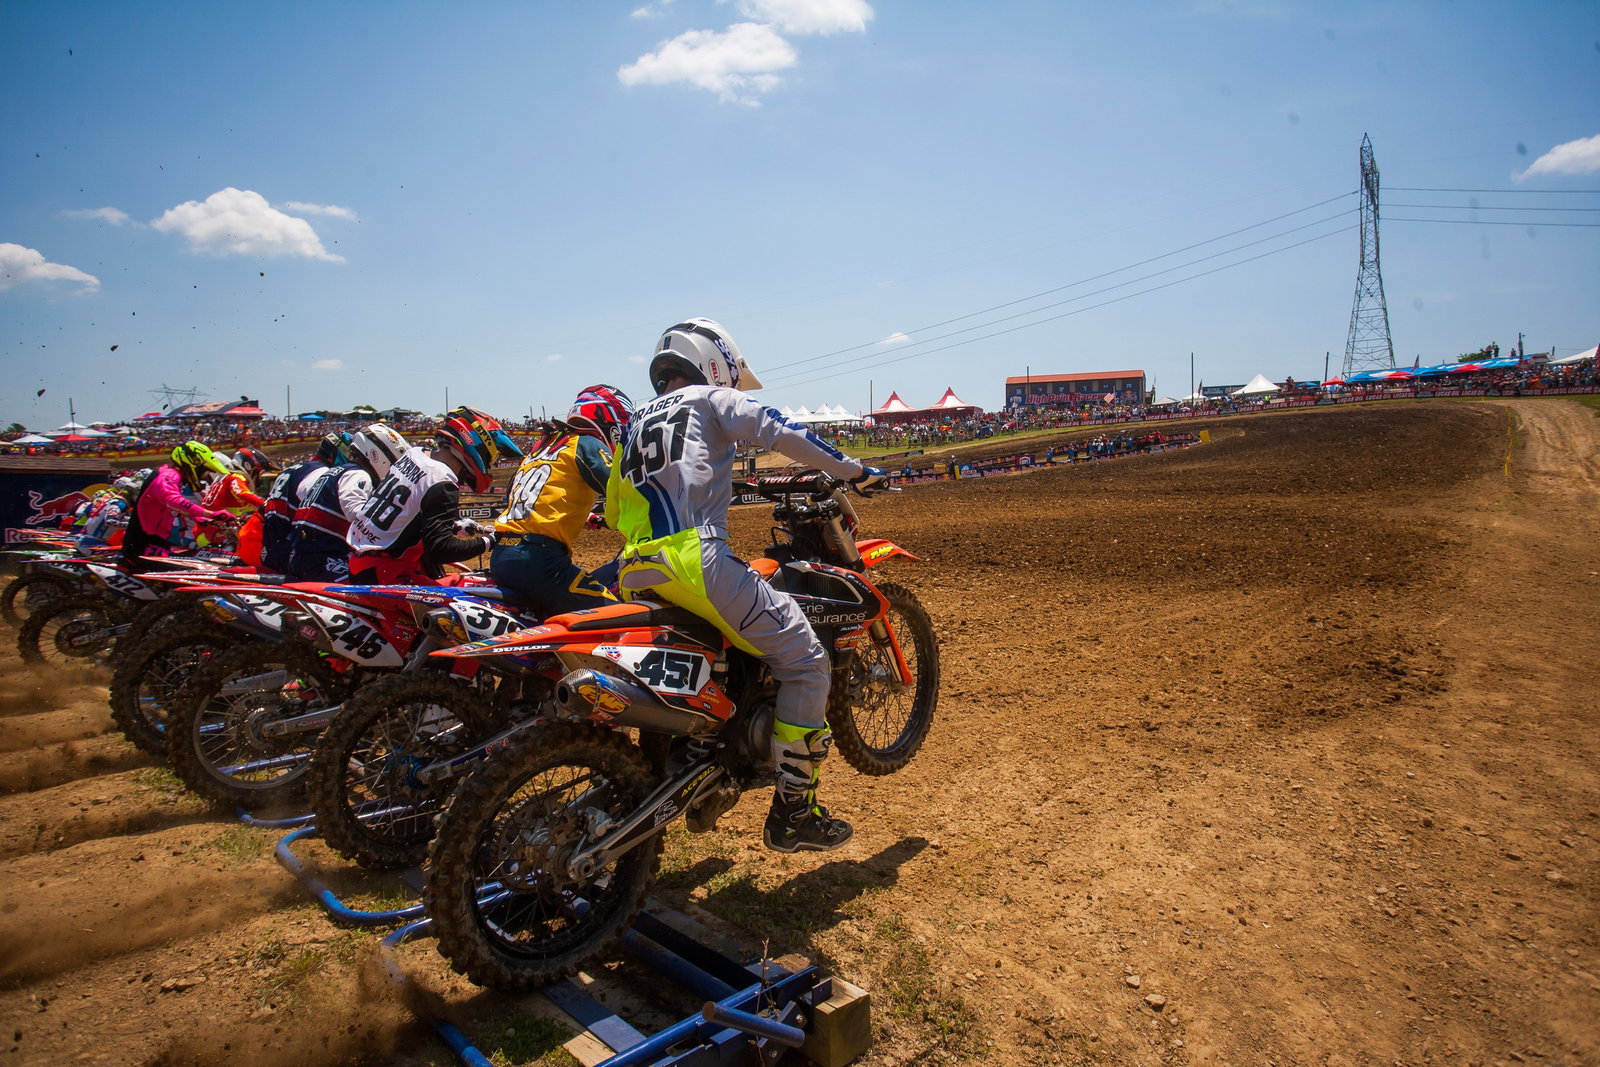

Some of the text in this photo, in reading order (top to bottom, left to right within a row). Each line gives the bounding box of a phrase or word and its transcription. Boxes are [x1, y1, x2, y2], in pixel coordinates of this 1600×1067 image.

[710, 361, 720, 381] BELL
[620, 406, 691, 485] 451
[459, 508, 492, 519] WPS
[800, 602, 825, 614] Erie
[807, 611, 866, 625] surance
[326, 614, 388, 660] 246
[492, 644, 551, 653] DUNLOP
[633, 650, 704, 692] 451
